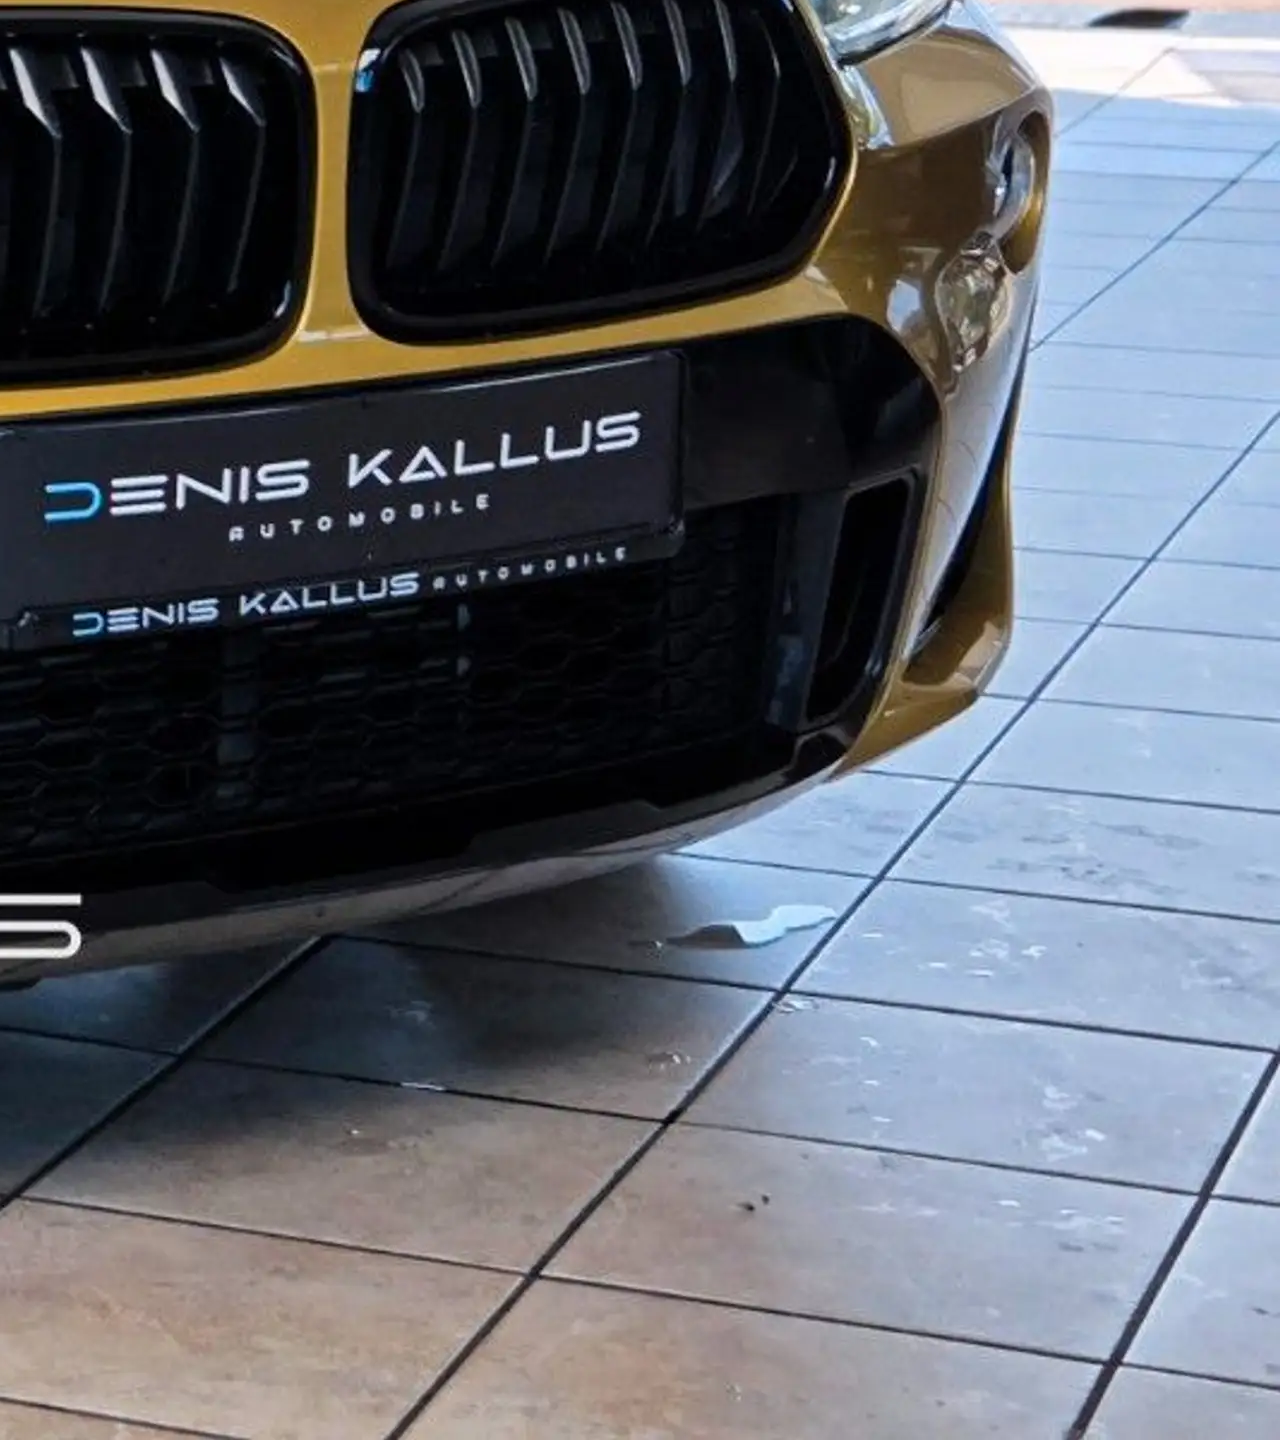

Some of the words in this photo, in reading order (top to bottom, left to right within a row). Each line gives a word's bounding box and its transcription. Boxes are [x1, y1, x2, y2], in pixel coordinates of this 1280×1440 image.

[44, 459, 310, 521] DENIS
[348, 410, 641, 488] KALLUS
[228, 493, 490, 542] AUTOMOBILE
[72, 597, 219, 637] DENIS
[240, 571, 420, 616] KALLUS
[432, 546, 627, 591] AUTOMOBILE
